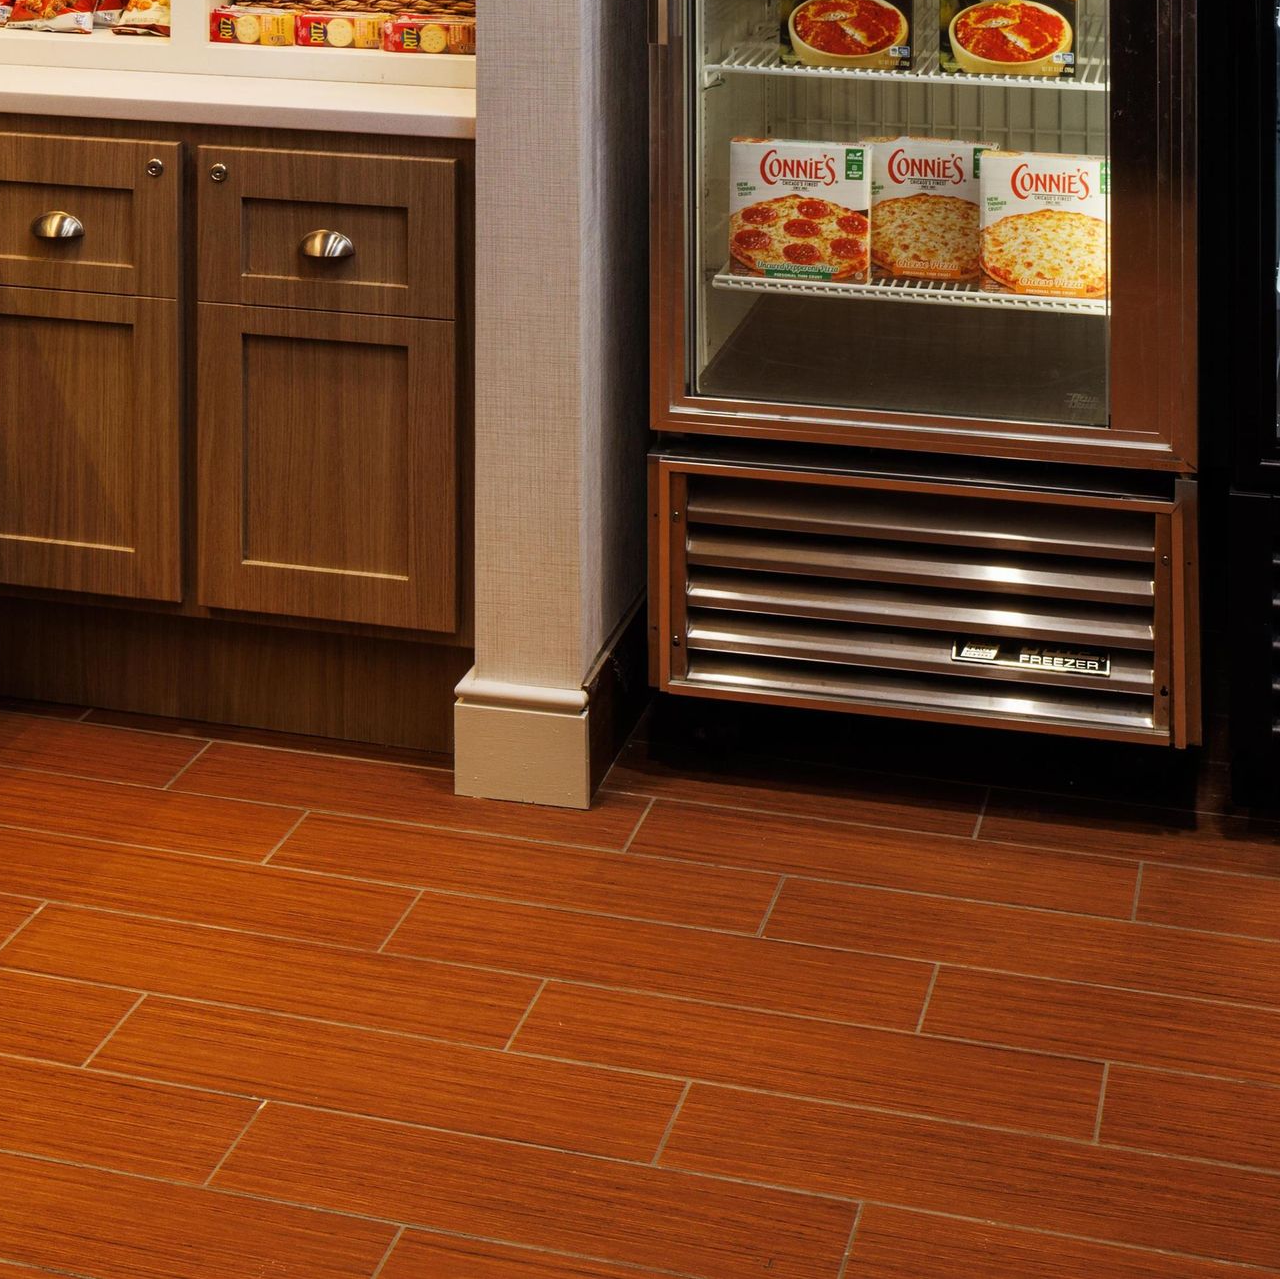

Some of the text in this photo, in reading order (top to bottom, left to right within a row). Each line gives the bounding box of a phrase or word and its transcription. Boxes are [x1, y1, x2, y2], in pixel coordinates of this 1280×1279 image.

[219, 17, 234, 39] RITZ
[310, 21, 325, 44] RITZ
[403, 27, 419, 49] RITZ
[760, 149, 836, 186] CONNIE'S
[888, 148, 964, 185] CONNIE'S
[1011, 163, 1090, 200] CONNIE'S
[757, 261, 785, 271] Uncured
[819, 264, 839, 273] Pizza
[896, 259, 960, 270] Cheese Pizza
[1019, 654, 1100, 671] FREEZER
